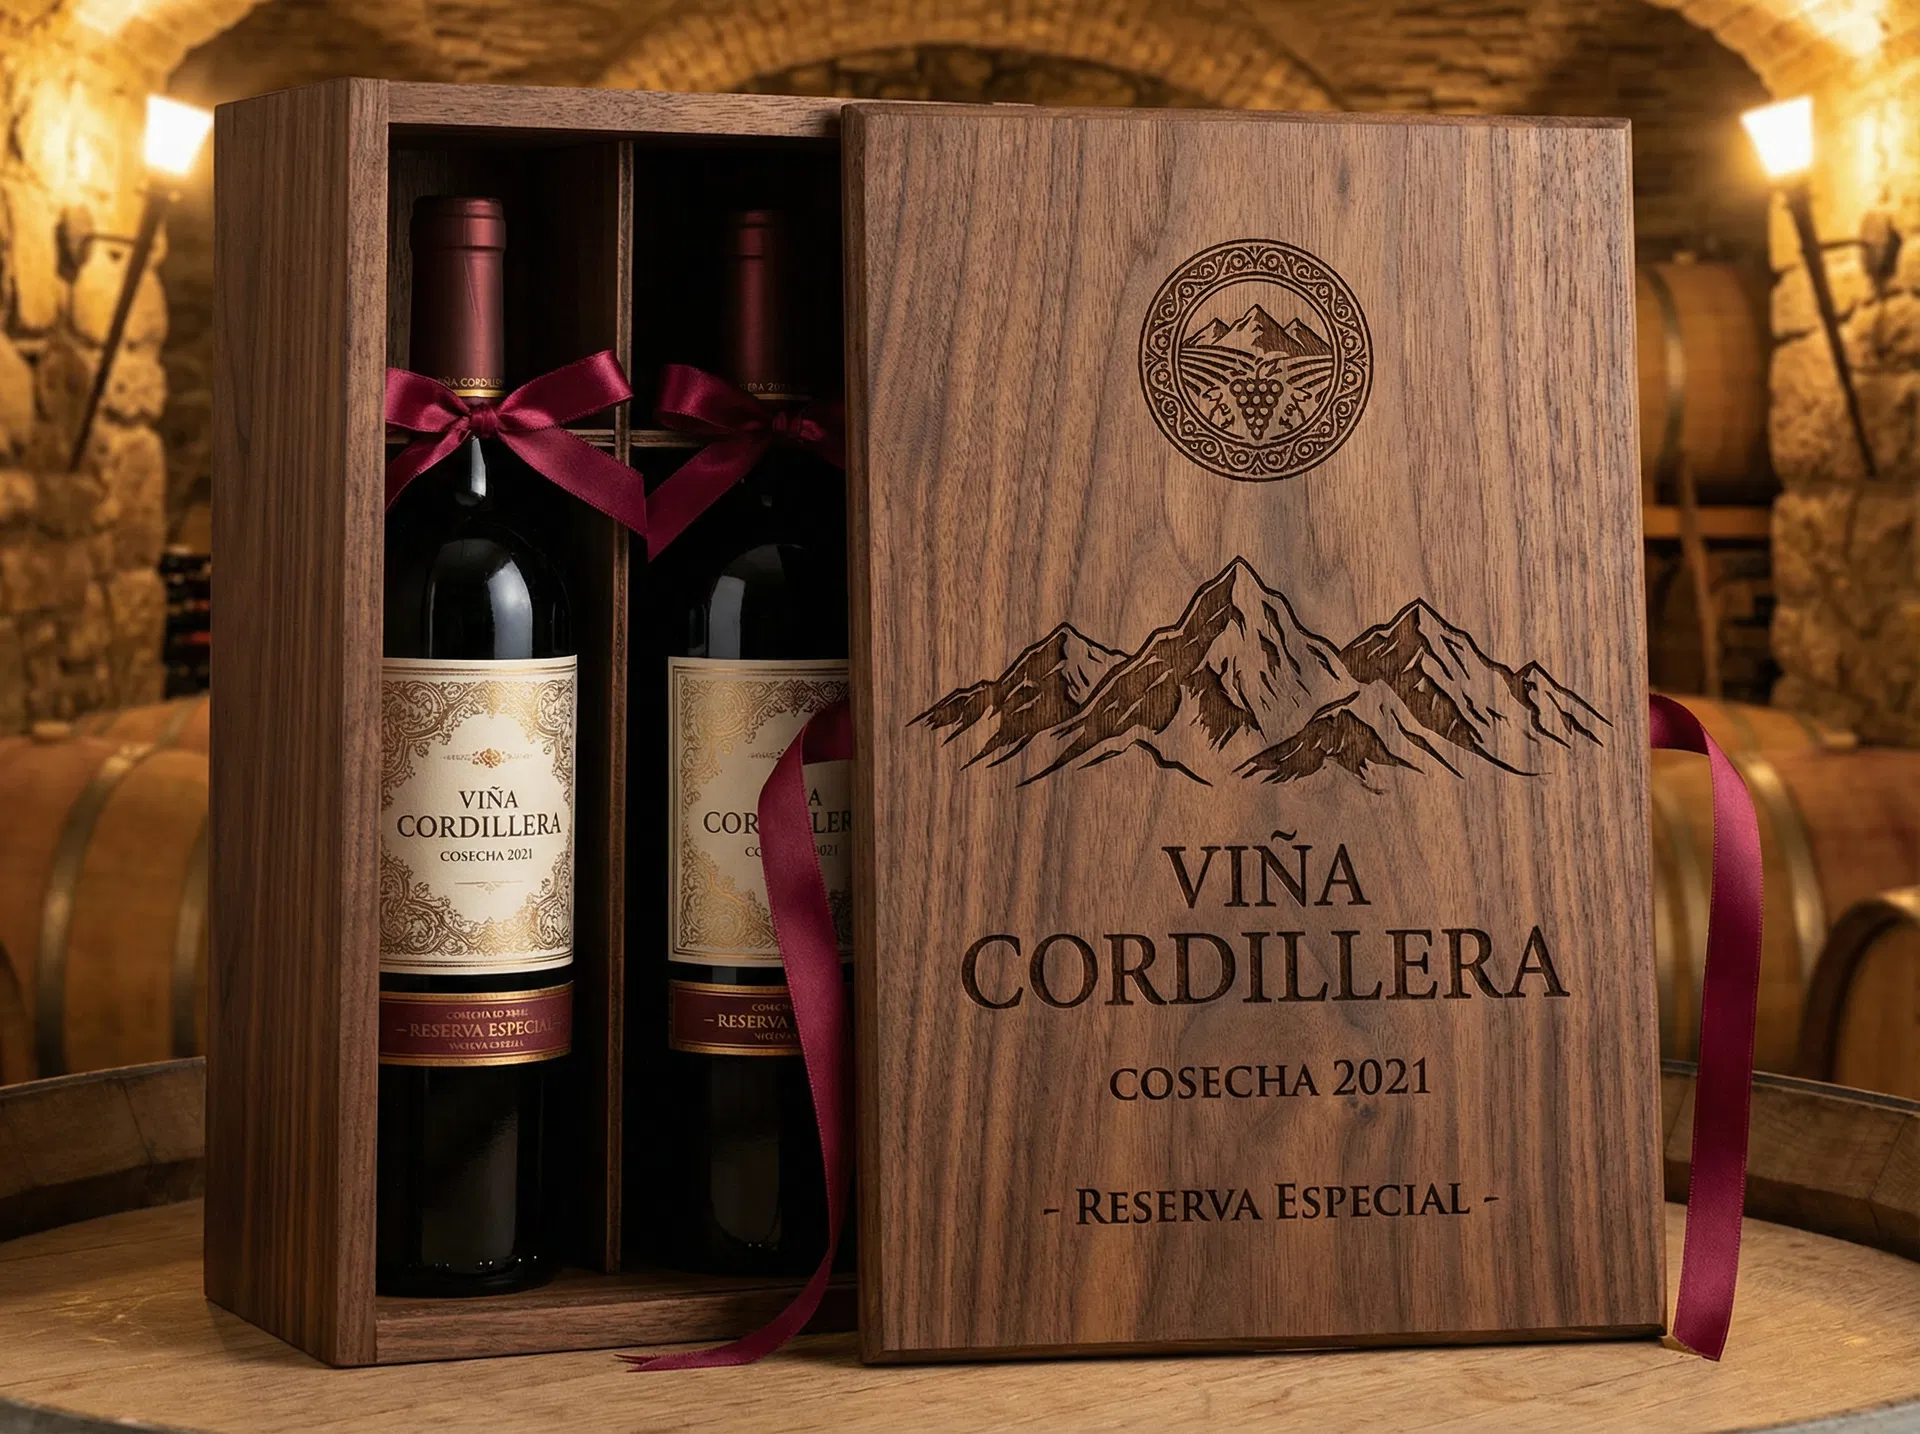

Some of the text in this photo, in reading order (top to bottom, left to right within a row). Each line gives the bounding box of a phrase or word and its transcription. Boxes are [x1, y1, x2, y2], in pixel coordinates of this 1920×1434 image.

[458, 786, 519, 809] VIÑA
[397, 812, 561, 838] CORDILLERA
[440, 848, 533, 862] COSECHA 2021
[816, 844, 838, 856] 021
[1161, 829, 1371, 908] VIÑA
[961, 925, 1570, 1009] CORDILLERA
[410, 1023, 484, 1038] RESERVA
[718, 1014, 788, 1029] RESERVA
[1109, 1057, 1431, 1101] COSECHA 2021
[1075, 1188, 1262, 1225] RESERVA
[1275, 1183, 1471, 1221] ESPECIAL
